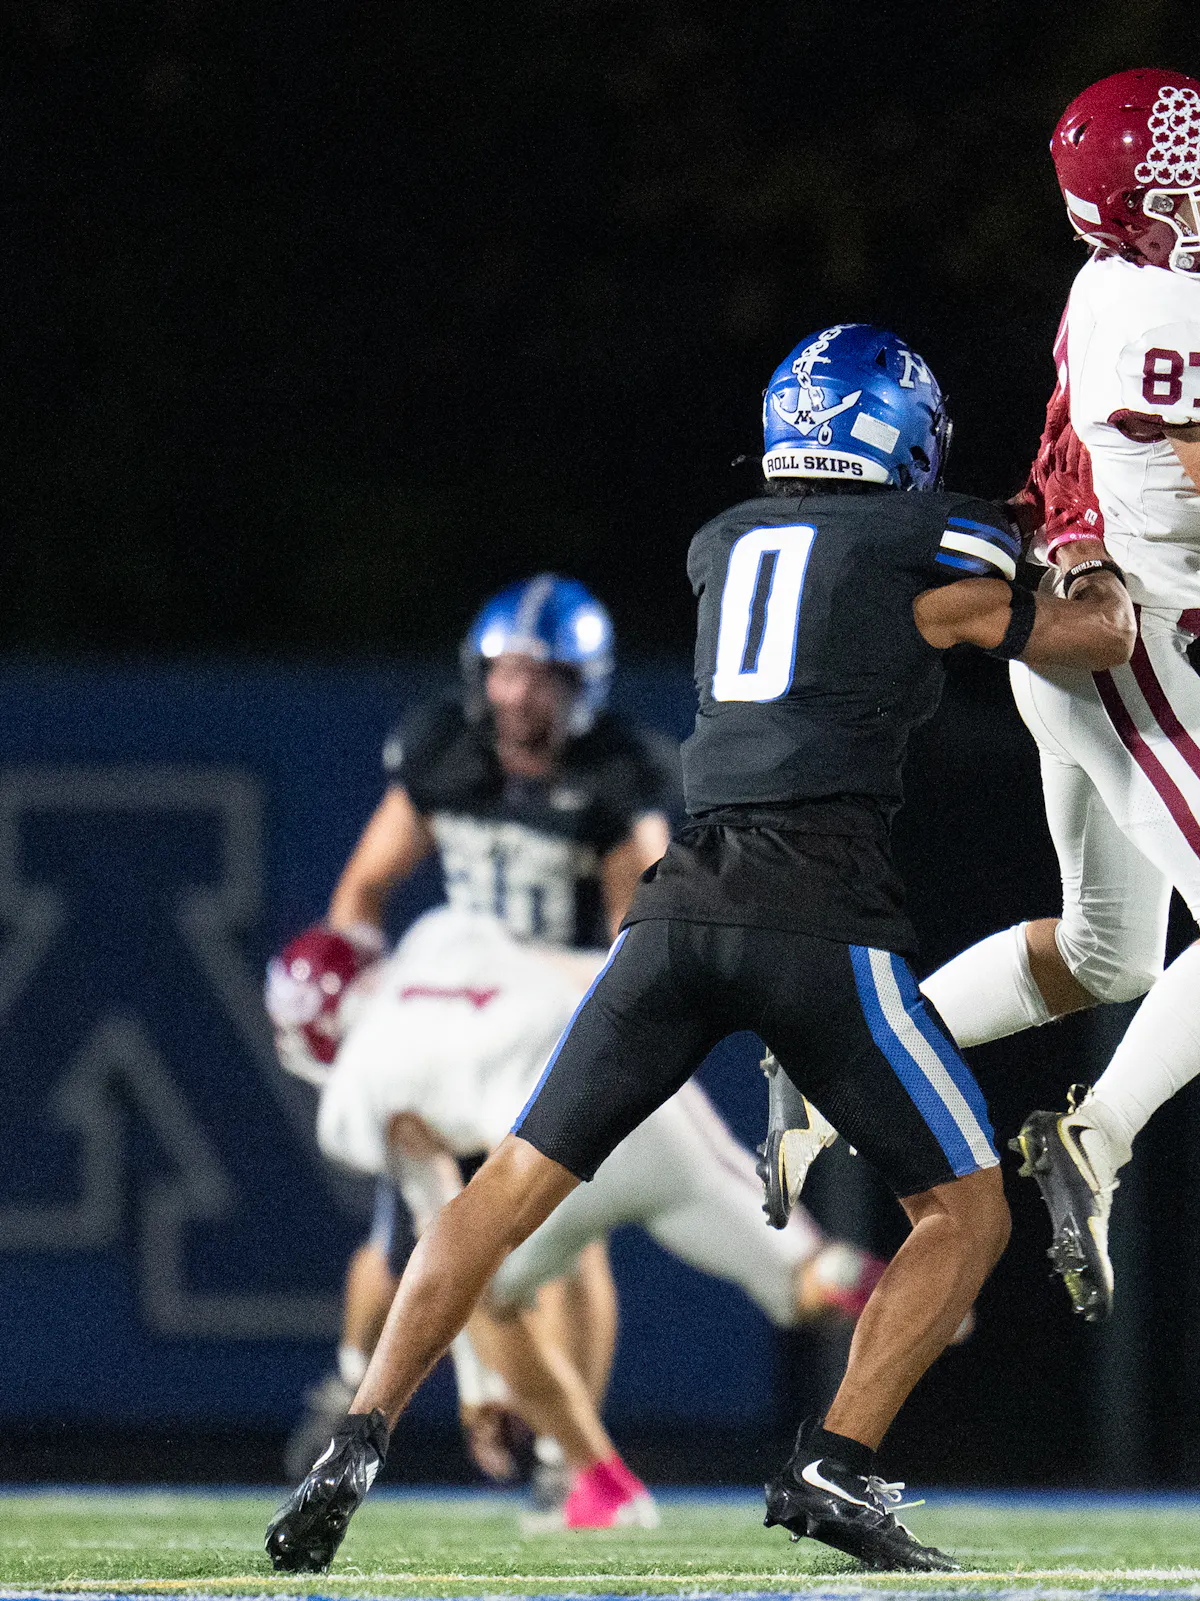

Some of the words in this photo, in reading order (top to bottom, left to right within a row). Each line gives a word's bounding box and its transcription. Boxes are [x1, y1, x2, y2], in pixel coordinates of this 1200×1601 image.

[794, 410, 816, 424] M
[767, 456, 799, 473] ROLL
[803, 456, 864, 477] SKIPS
[712, 522, 818, 703] 0
